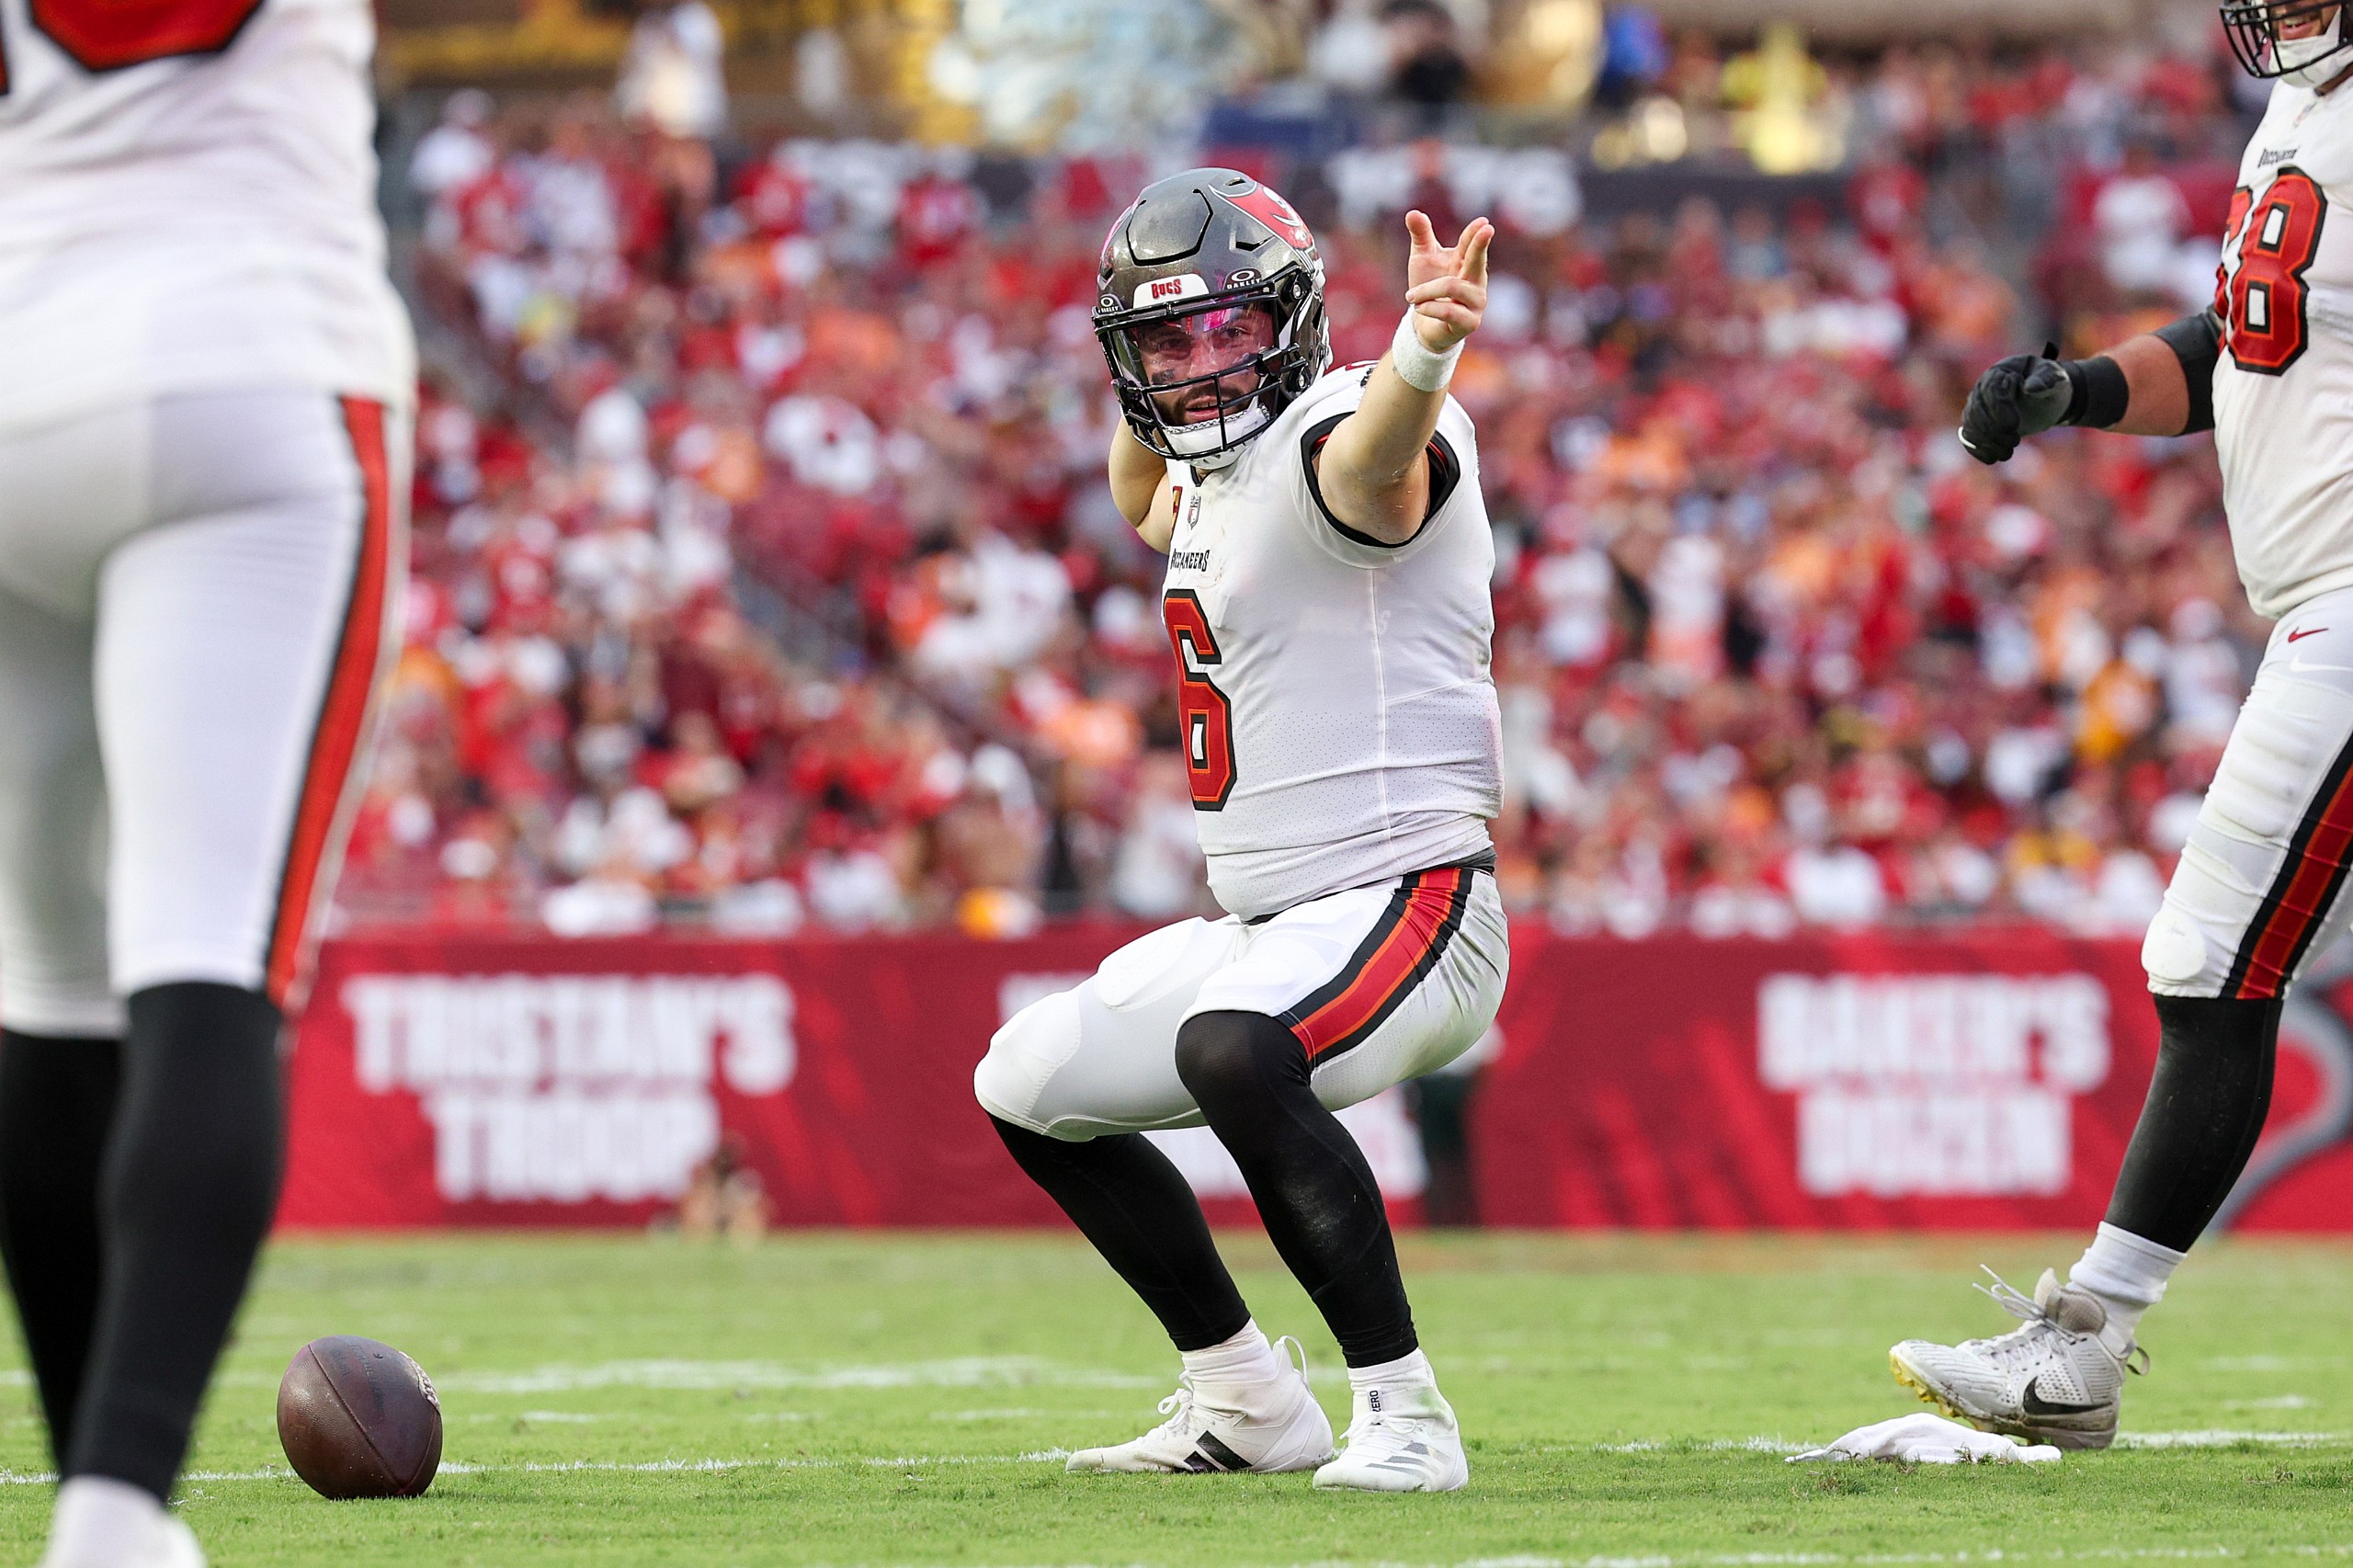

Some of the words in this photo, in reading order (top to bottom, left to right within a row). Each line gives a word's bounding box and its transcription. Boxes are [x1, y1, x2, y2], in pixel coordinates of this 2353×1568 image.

[1164, 588, 1237, 812] 6
[341, 972, 796, 1094] TRISTAN'S
[1758, 971, 2110, 1093] BAKER'S
[421, 1091, 719, 1202] TROOP
[1799, 1091, 2072, 1196] DOZEN
